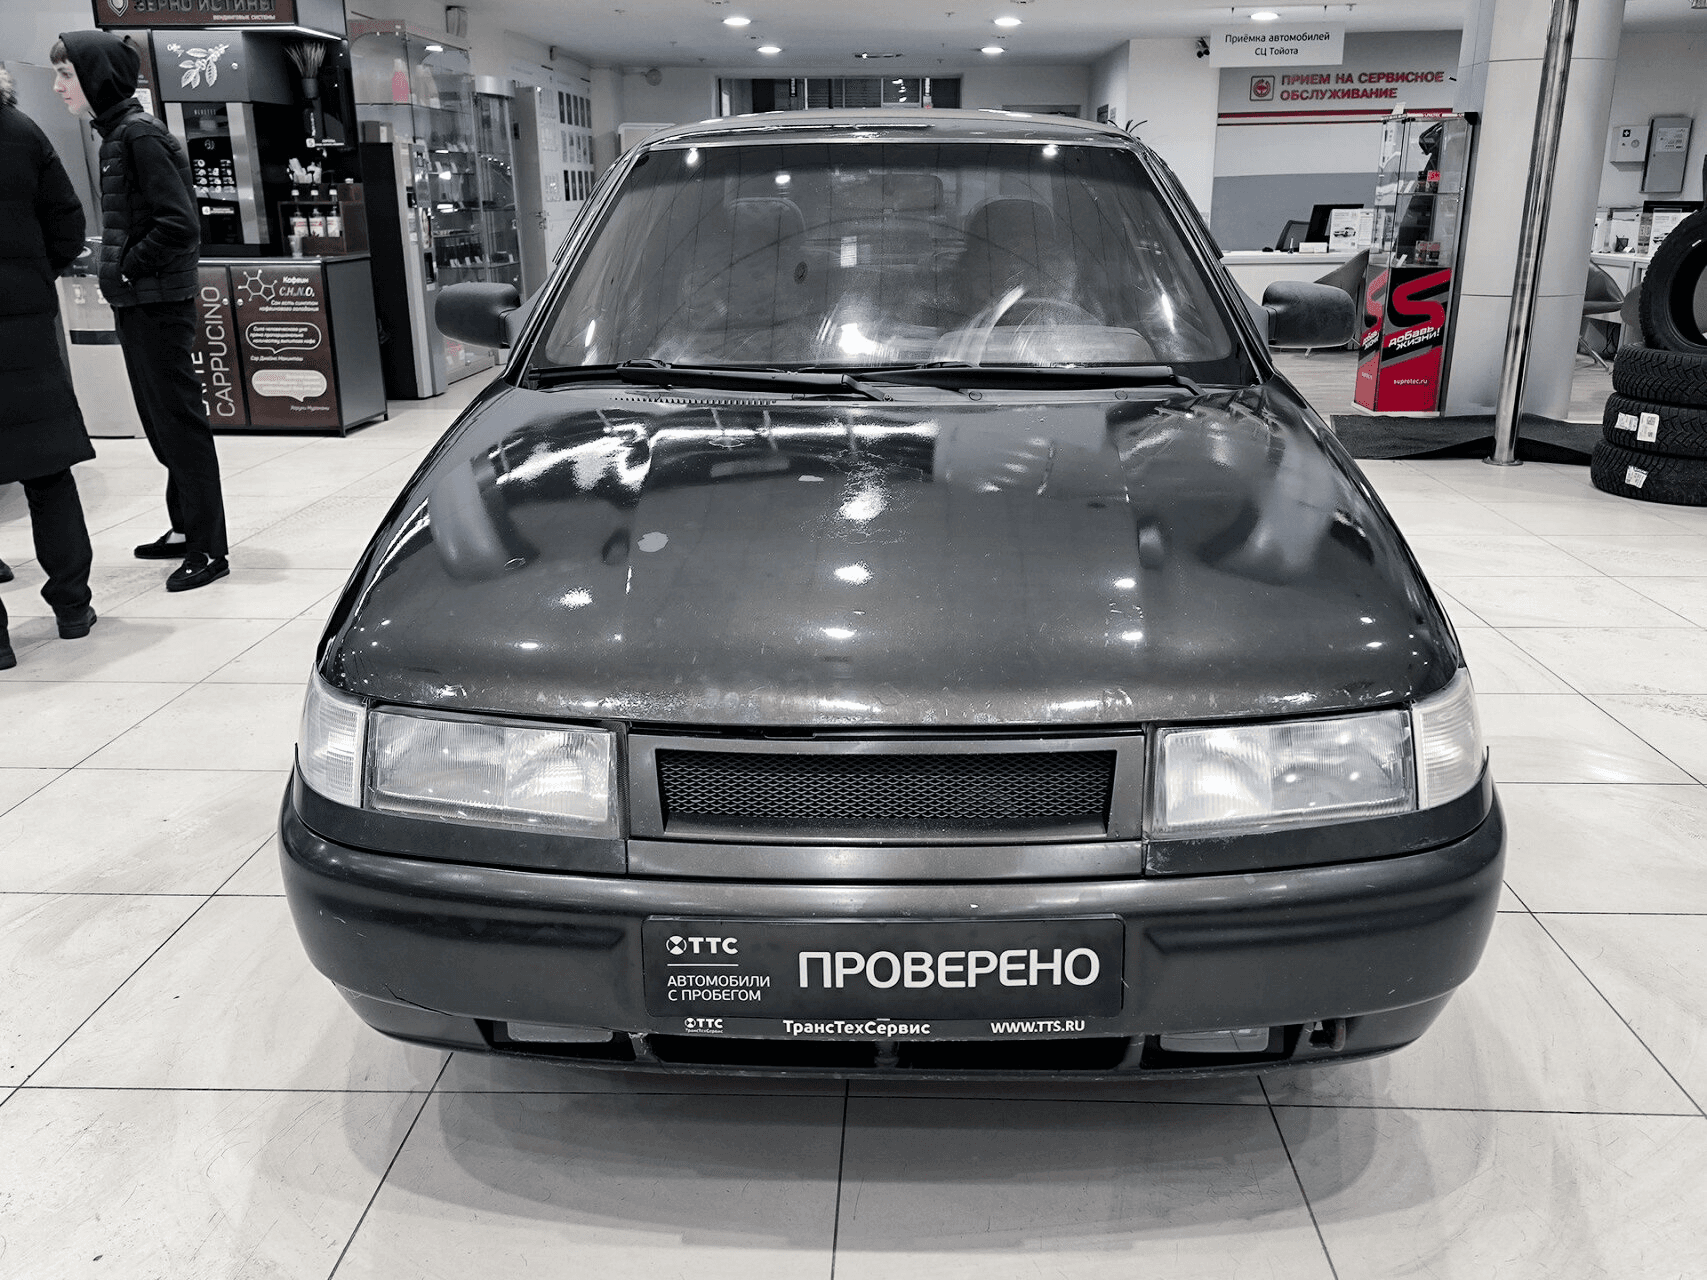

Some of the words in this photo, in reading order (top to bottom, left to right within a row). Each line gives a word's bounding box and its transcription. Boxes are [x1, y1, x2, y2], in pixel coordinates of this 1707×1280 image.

[1225, 34, 1266, 45] Приёмка
[1268, 32, 1330, 42] автомобилей
[1255, 47, 1267, 56] СЦ
[1270, 47, 1299, 55] Тойота
[1281, 73, 1330, 85] ПРИЕМ
[1335, 72, 1354, 84] НА
[1358, 71, 1444, 84] СЕРВИСНОЕ
[1280, 88, 1398, 100] ОБСЛУЖИВАНИЕ
[1388, 326, 1434, 348] добавь
[1396, 328, 1441, 350] жизни!
[200, 286, 236, 417] CAPPUCINO
[688, 936, 739, 954] ТТС
[799, 947, 1100, 989] ПРОВЕРЕНО
[667, 975, 771, 988] АВТОМОБИЛИ
[668, 989, 678, 1001] С
[681, 989, 761, 1001] ПРОБЕГОМ
[696, 1018, 723, 1028] ТТС
[783, 1020, 931, 1037] ТрансТехСервис
[991, 1019, 1086, 1035] WWW.TTS.RU
